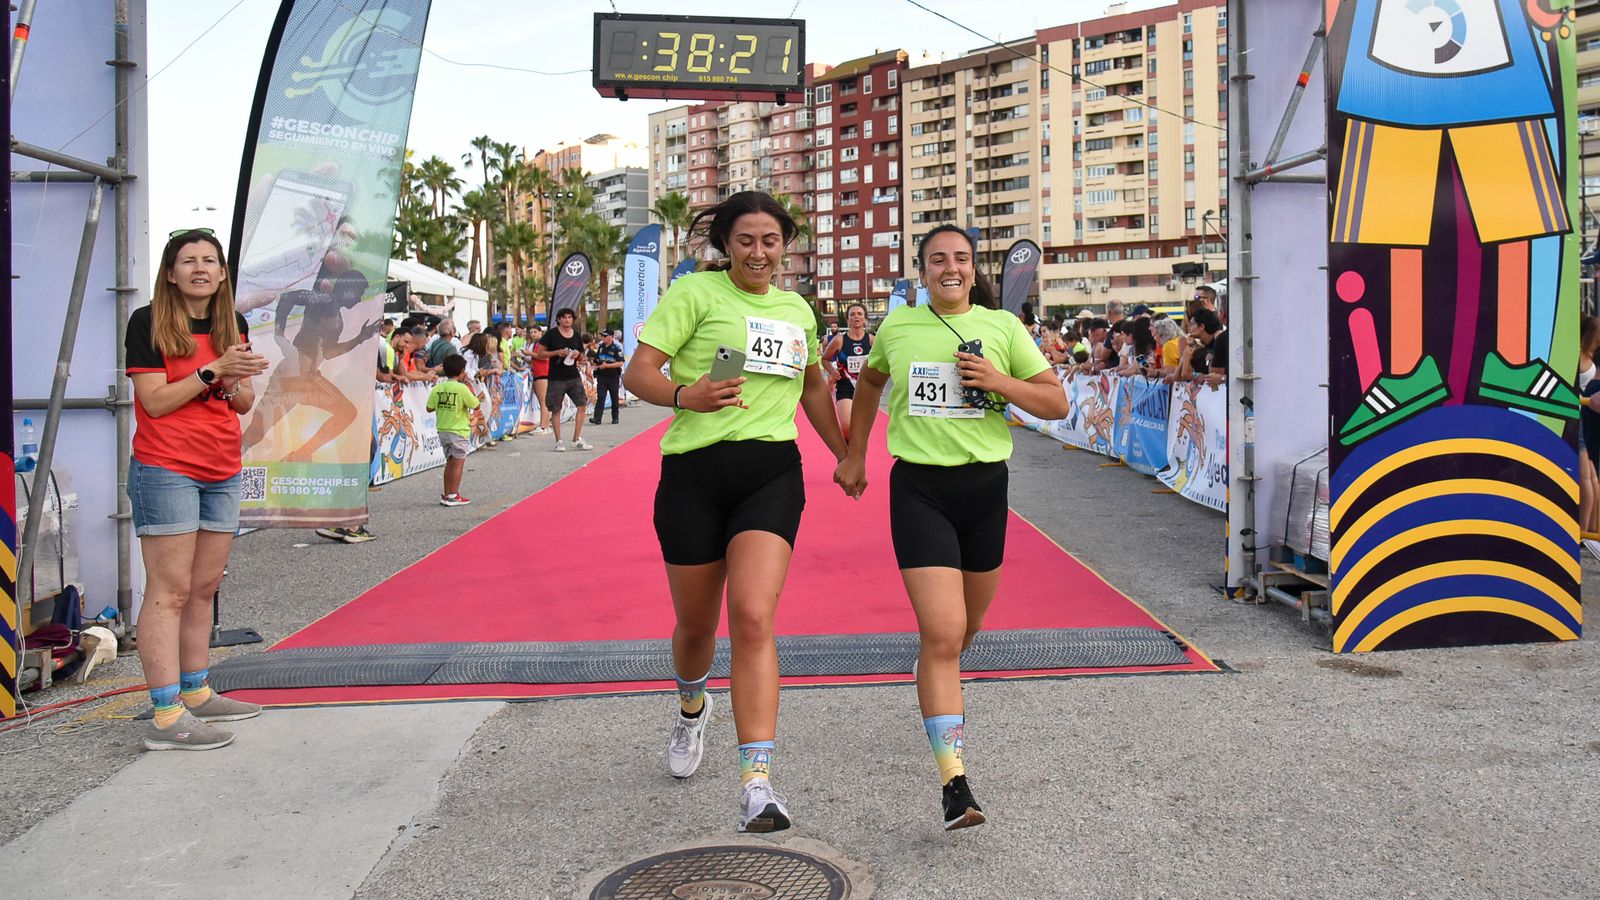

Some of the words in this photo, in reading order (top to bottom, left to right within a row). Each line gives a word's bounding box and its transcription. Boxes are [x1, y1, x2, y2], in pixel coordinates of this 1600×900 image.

[662, 74, 679, 82] chip
[368, 143, 398, 157] VIVO
[751, 336, 784, 359] 437
[912, 366, 925, 376] XXI
[914, 381, 947, 402] 431
[270, 476, 359, 487] GESCONCHIP.ES
[270, 485, 288, 494] 615
[288, 486, 311, 495] 980
[312, 486, 333, 496] 784
